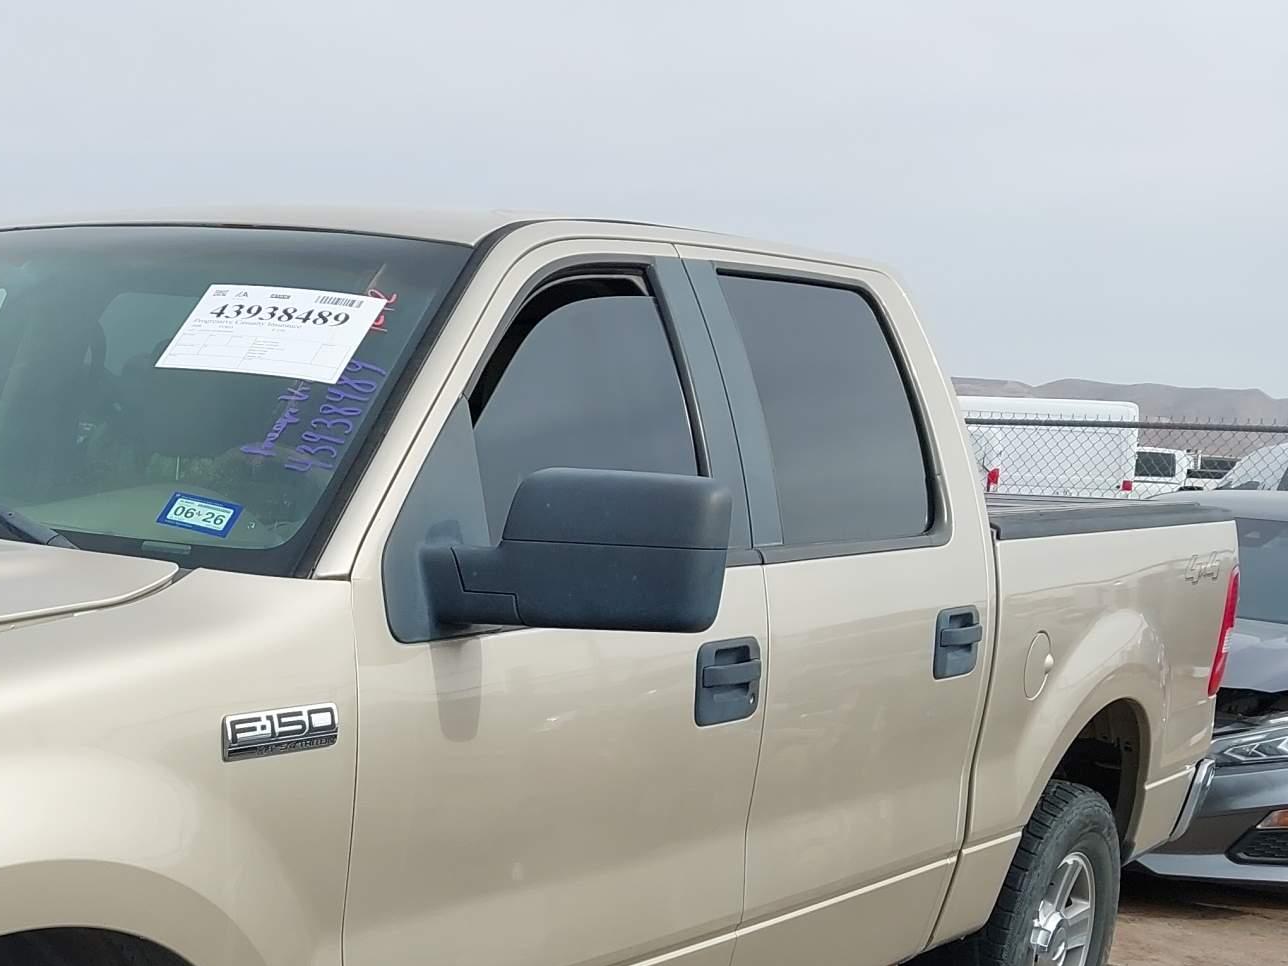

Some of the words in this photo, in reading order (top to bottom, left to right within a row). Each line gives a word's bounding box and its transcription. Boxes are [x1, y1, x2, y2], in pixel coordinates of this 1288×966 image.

[210, 303, 350, 327] 43938489
[174, 505, 196, 519] 06
[202, 511, 226, 526] 26
